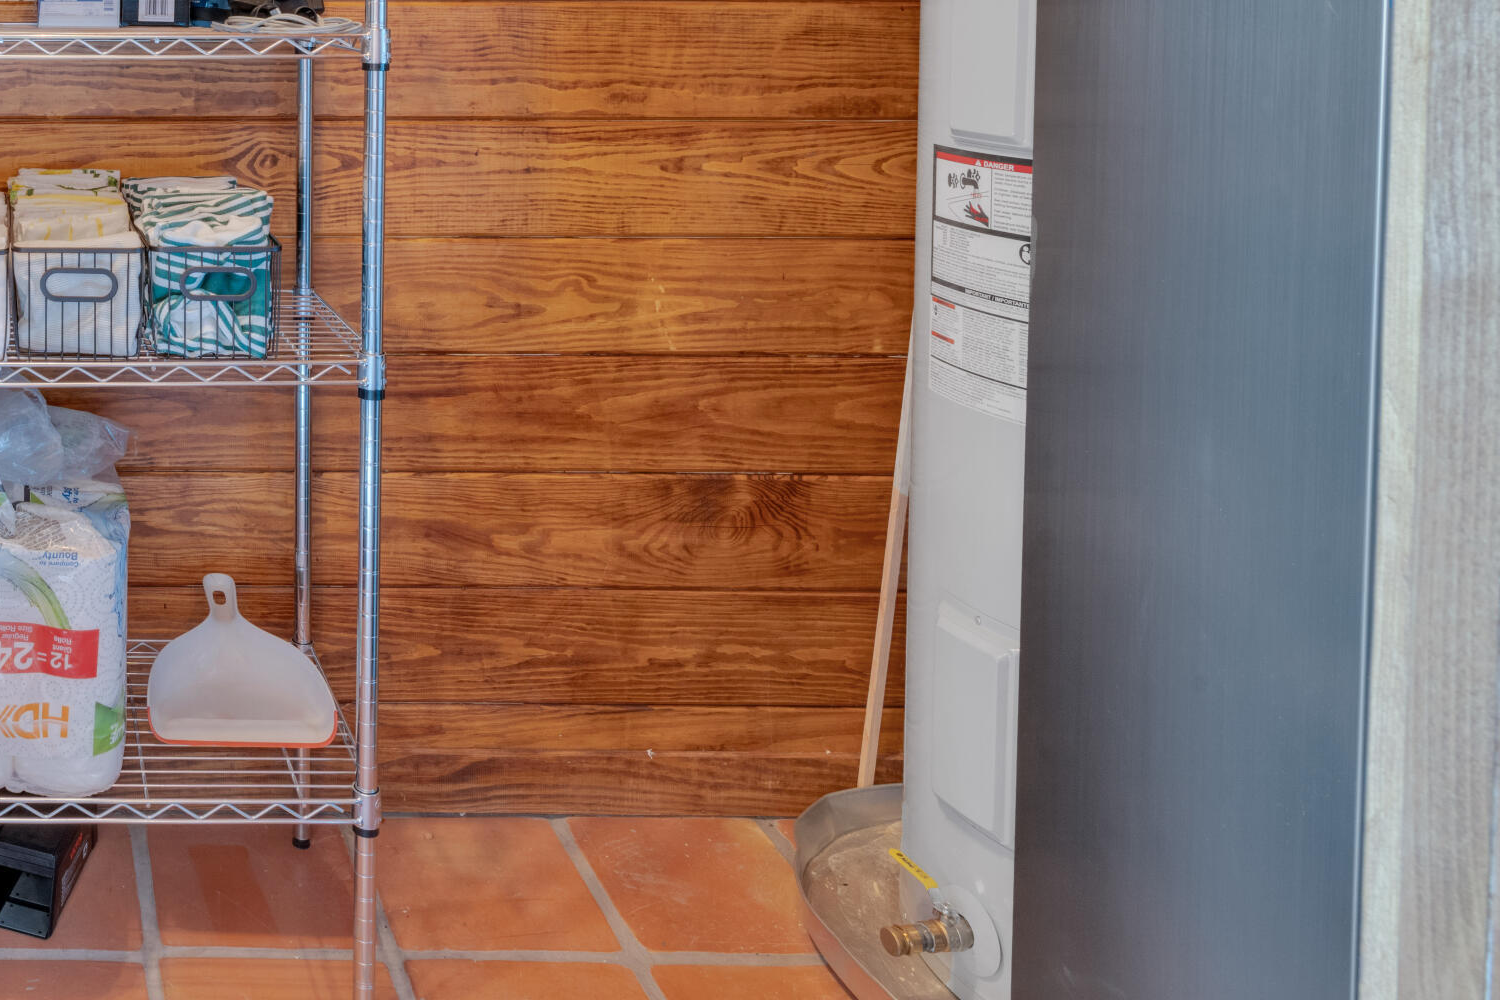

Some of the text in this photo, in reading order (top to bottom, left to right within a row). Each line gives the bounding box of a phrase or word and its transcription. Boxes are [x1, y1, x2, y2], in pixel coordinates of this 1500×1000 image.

[983, 160, 1014, 172] DANGER
[42, 552, 78, 561] Bounty
[18, 625, 33, 633] Size
[1, 634, 29, 642] Regular
[53, 635, 72, 645] Rolls
[52, 645, 72, 655] Giant
[51, 651, 73, 670] 12
